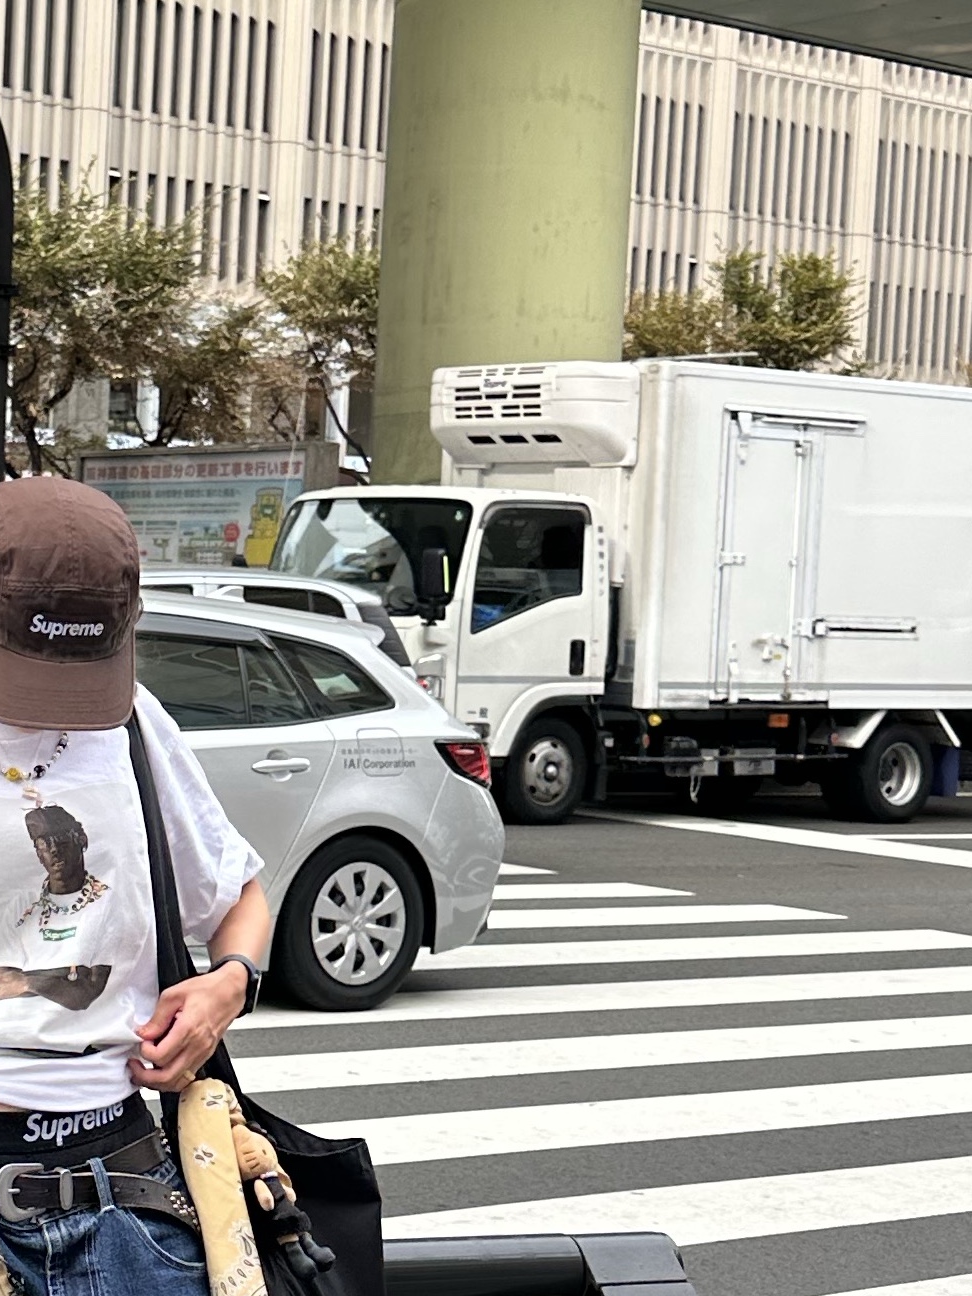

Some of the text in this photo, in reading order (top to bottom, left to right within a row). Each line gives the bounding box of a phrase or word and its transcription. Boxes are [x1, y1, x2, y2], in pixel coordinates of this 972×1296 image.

[29, 613, 105, 640] Supreme
[363, 758, 416, 770] Corporation
[22, 1098, 125, 1148] Supreme
